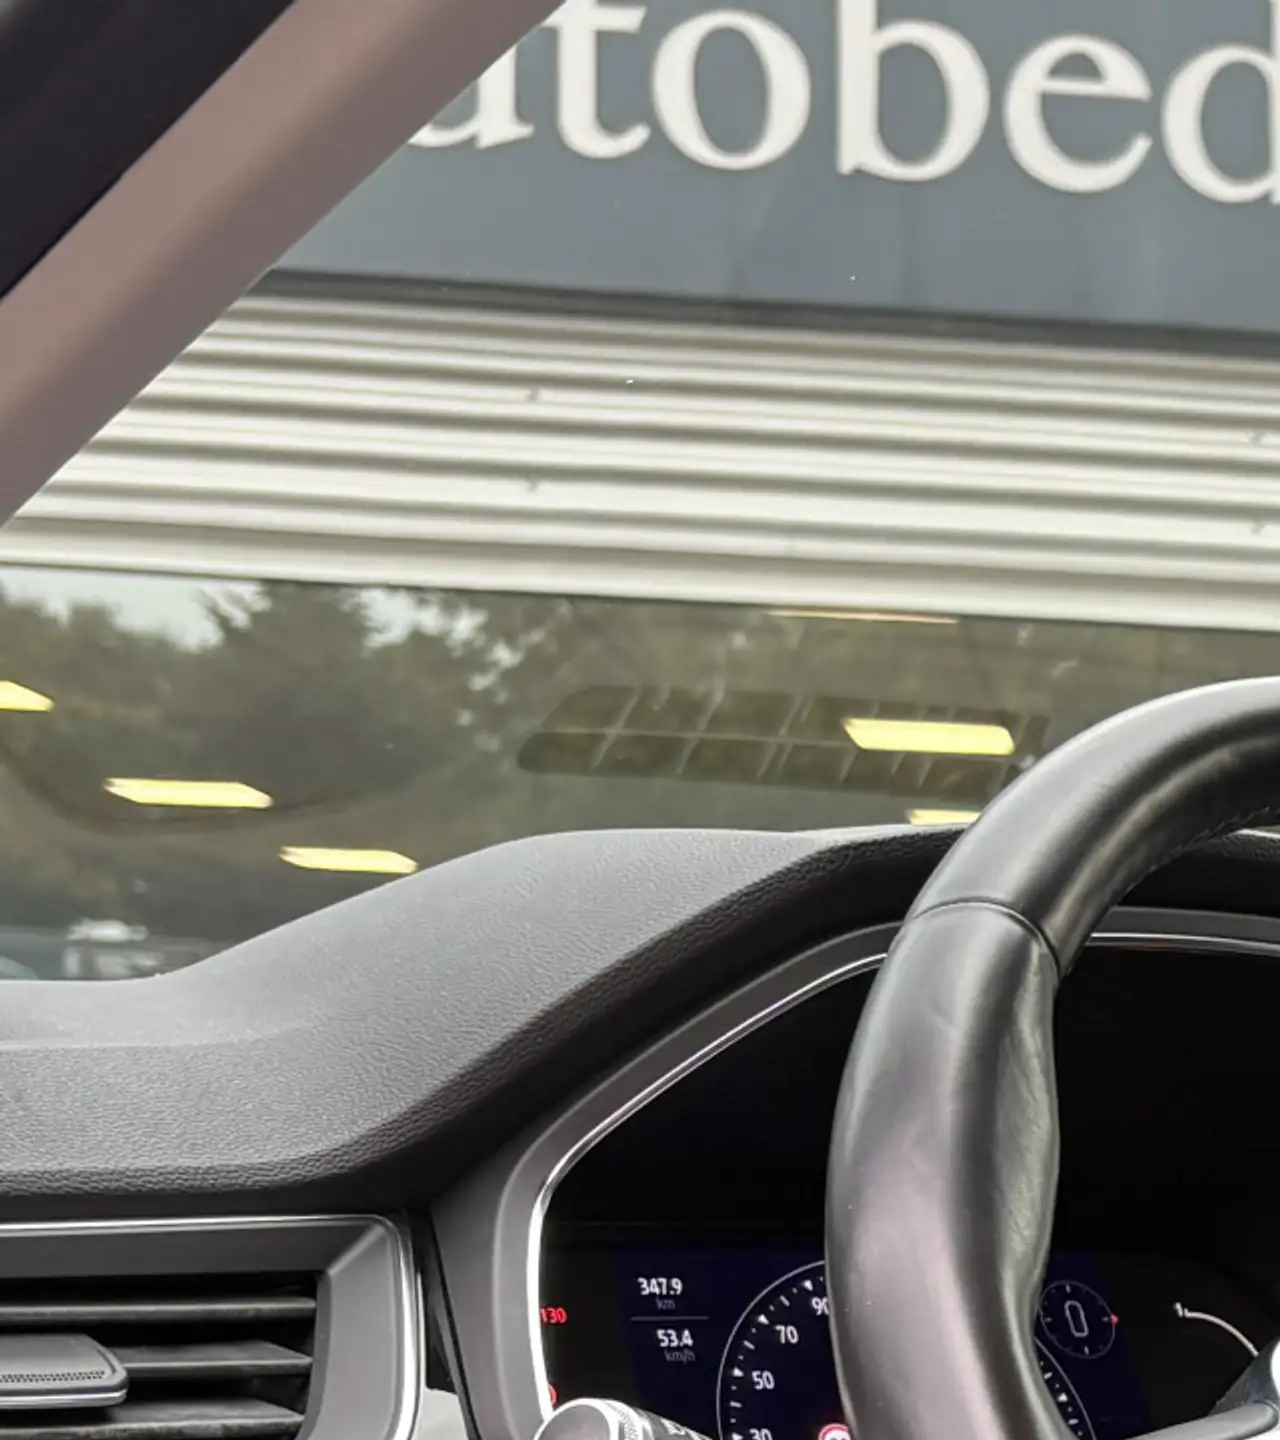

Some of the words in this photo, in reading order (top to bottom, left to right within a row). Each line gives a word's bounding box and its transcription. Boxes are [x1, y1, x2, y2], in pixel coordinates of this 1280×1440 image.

[637, 1277, 684, 1296] 347.9
[655, 1329, 694, 1348] 53.4
[775, 1325, 800, 1345] 70
[752, 1370, 776, 1390] 50
